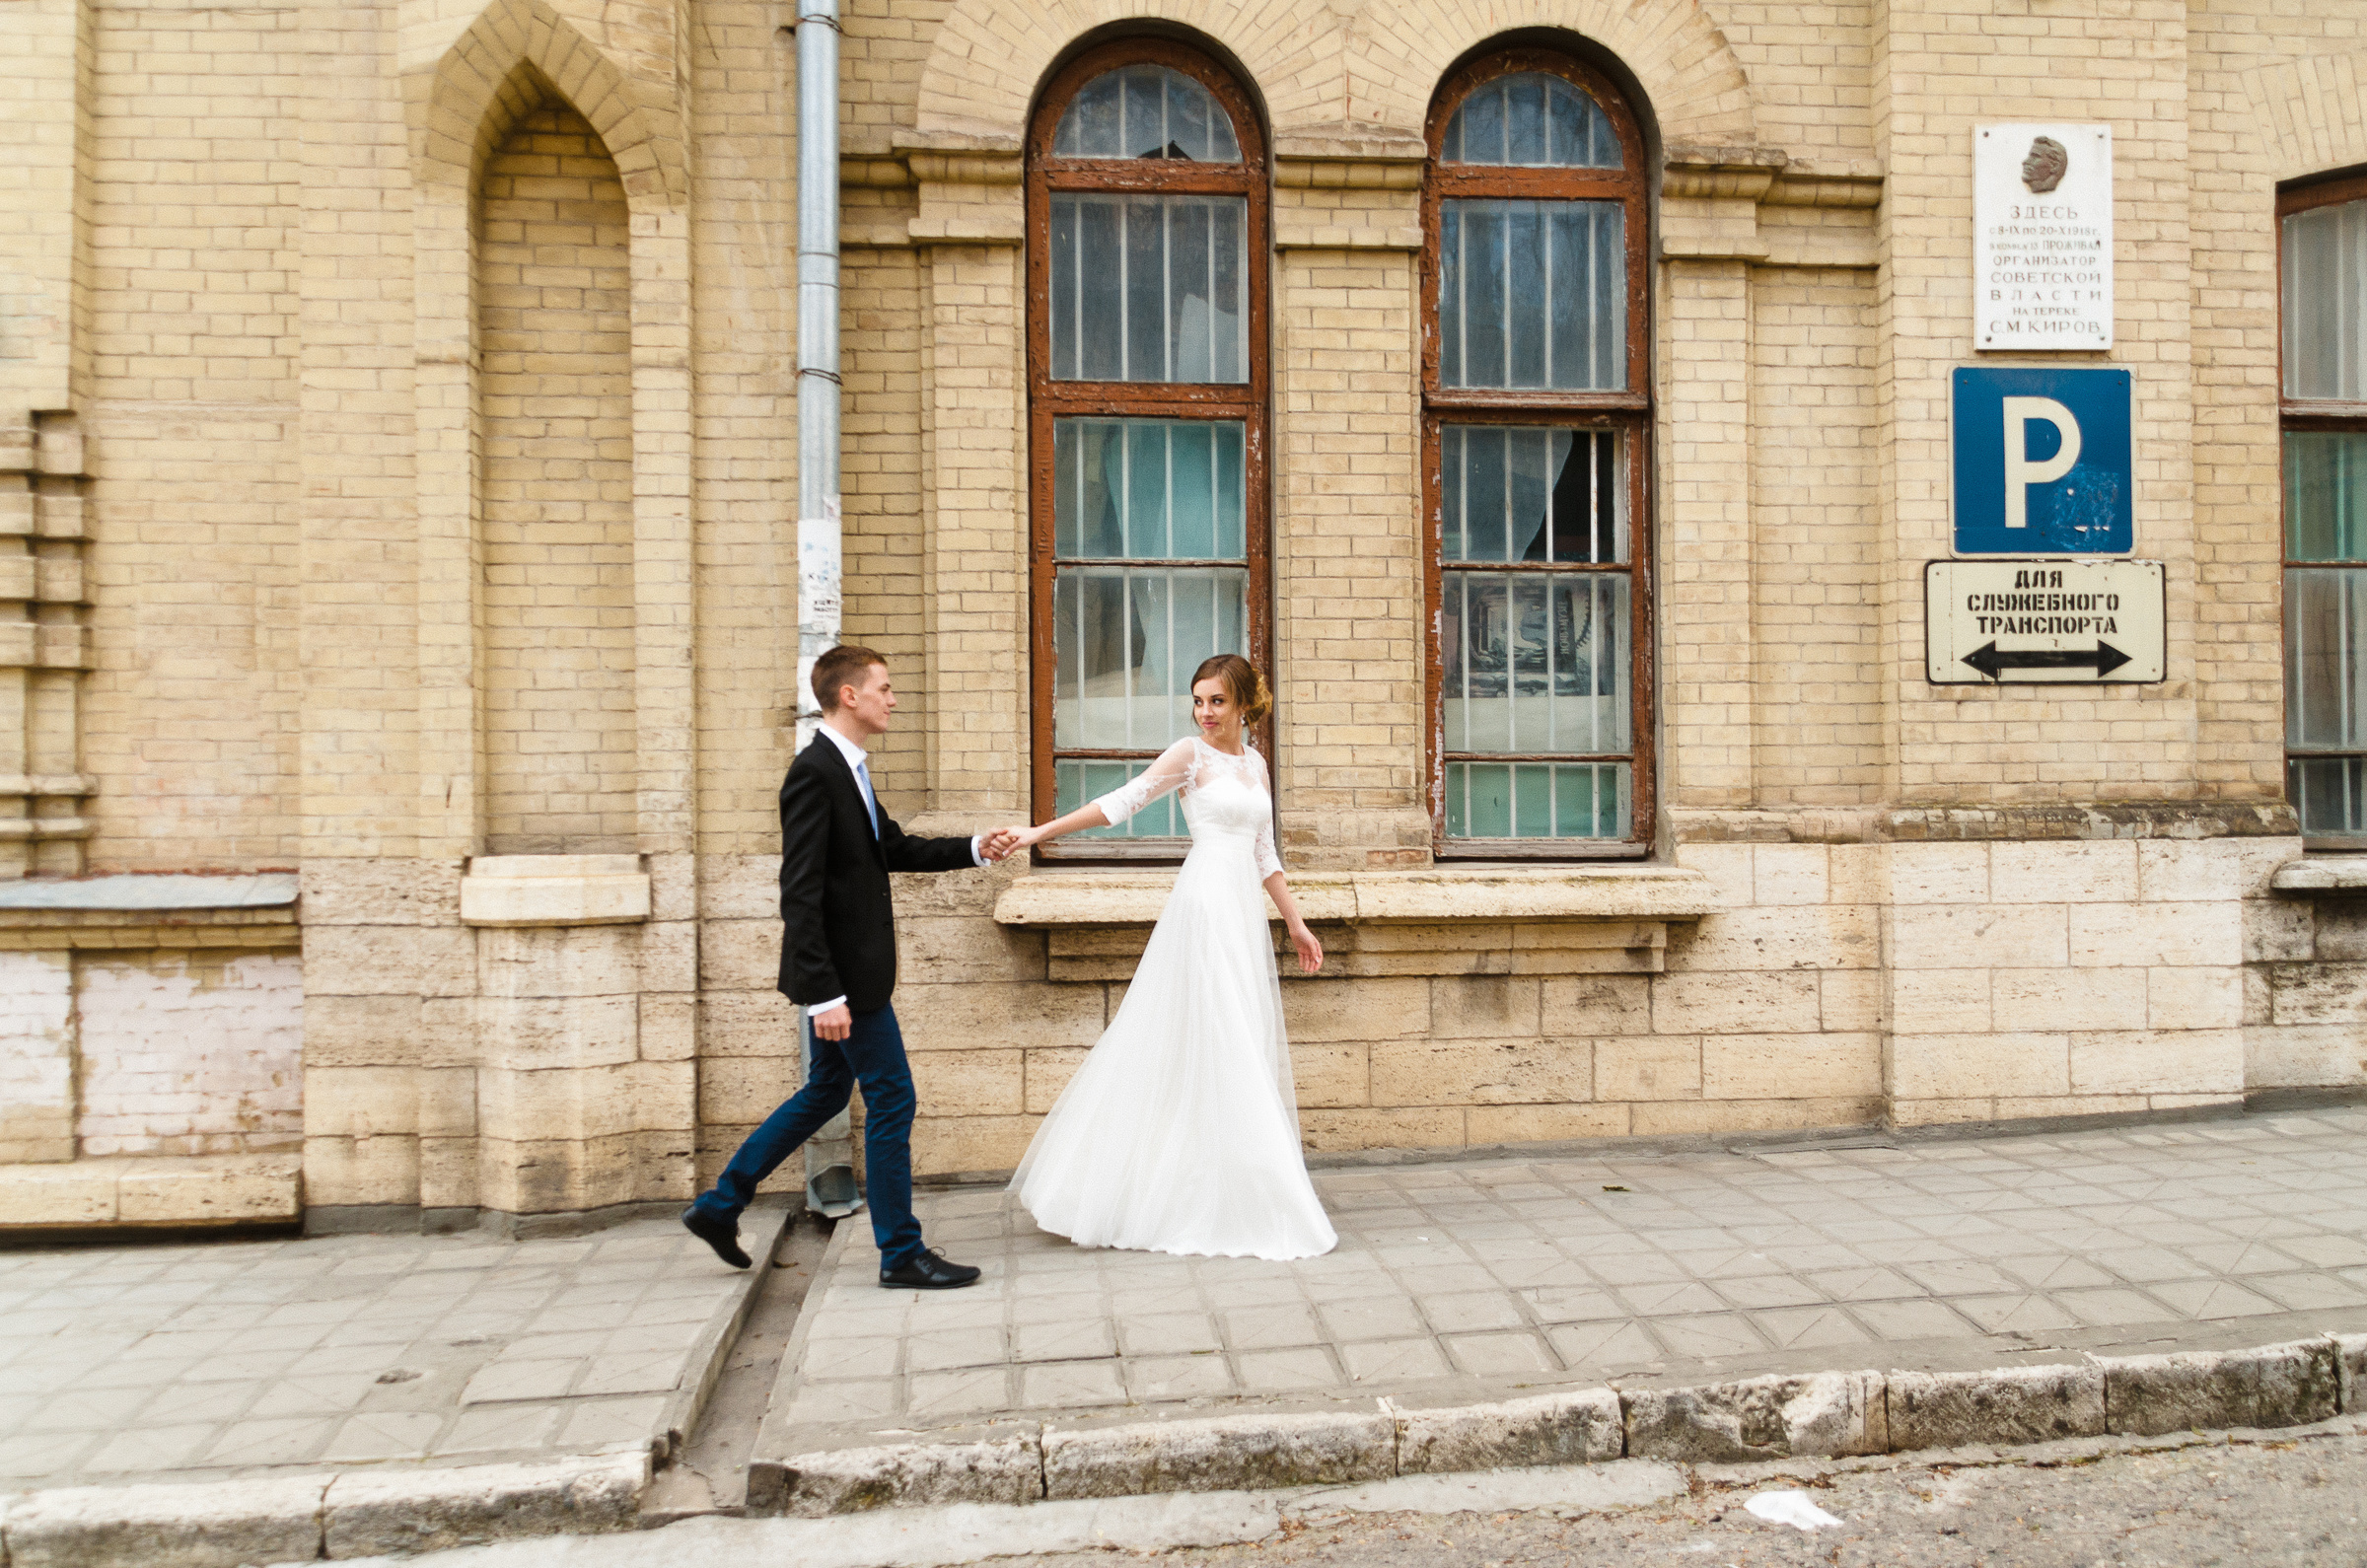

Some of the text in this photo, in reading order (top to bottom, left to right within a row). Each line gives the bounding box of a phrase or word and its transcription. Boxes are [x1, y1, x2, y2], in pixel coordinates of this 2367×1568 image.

[2010, 205, 2078, 219] ЗДЕСЬ
[1998, 226, 2020, 236] 8-IX
[2043, 240, 2101, 250] ПРОЖИВАЛ
[1993, 255, 2097, 266] ОРГАНИЗАТОР
[1990, 271, 2101, 284] СОВЕТСКОЙ
[1990, 290, 2101, 301] ВЛАСТИ
[2028, 321, 2101, 333] КИРОВ
[2002, 395, 2082, 529] P
[2014, 570, 2063, 589] ДЛЯ
[1967, 594, 2119, 611] СЛУЖЕБНОГО
[1975, 615, 2118, 634] ТРАНСПОРТА
